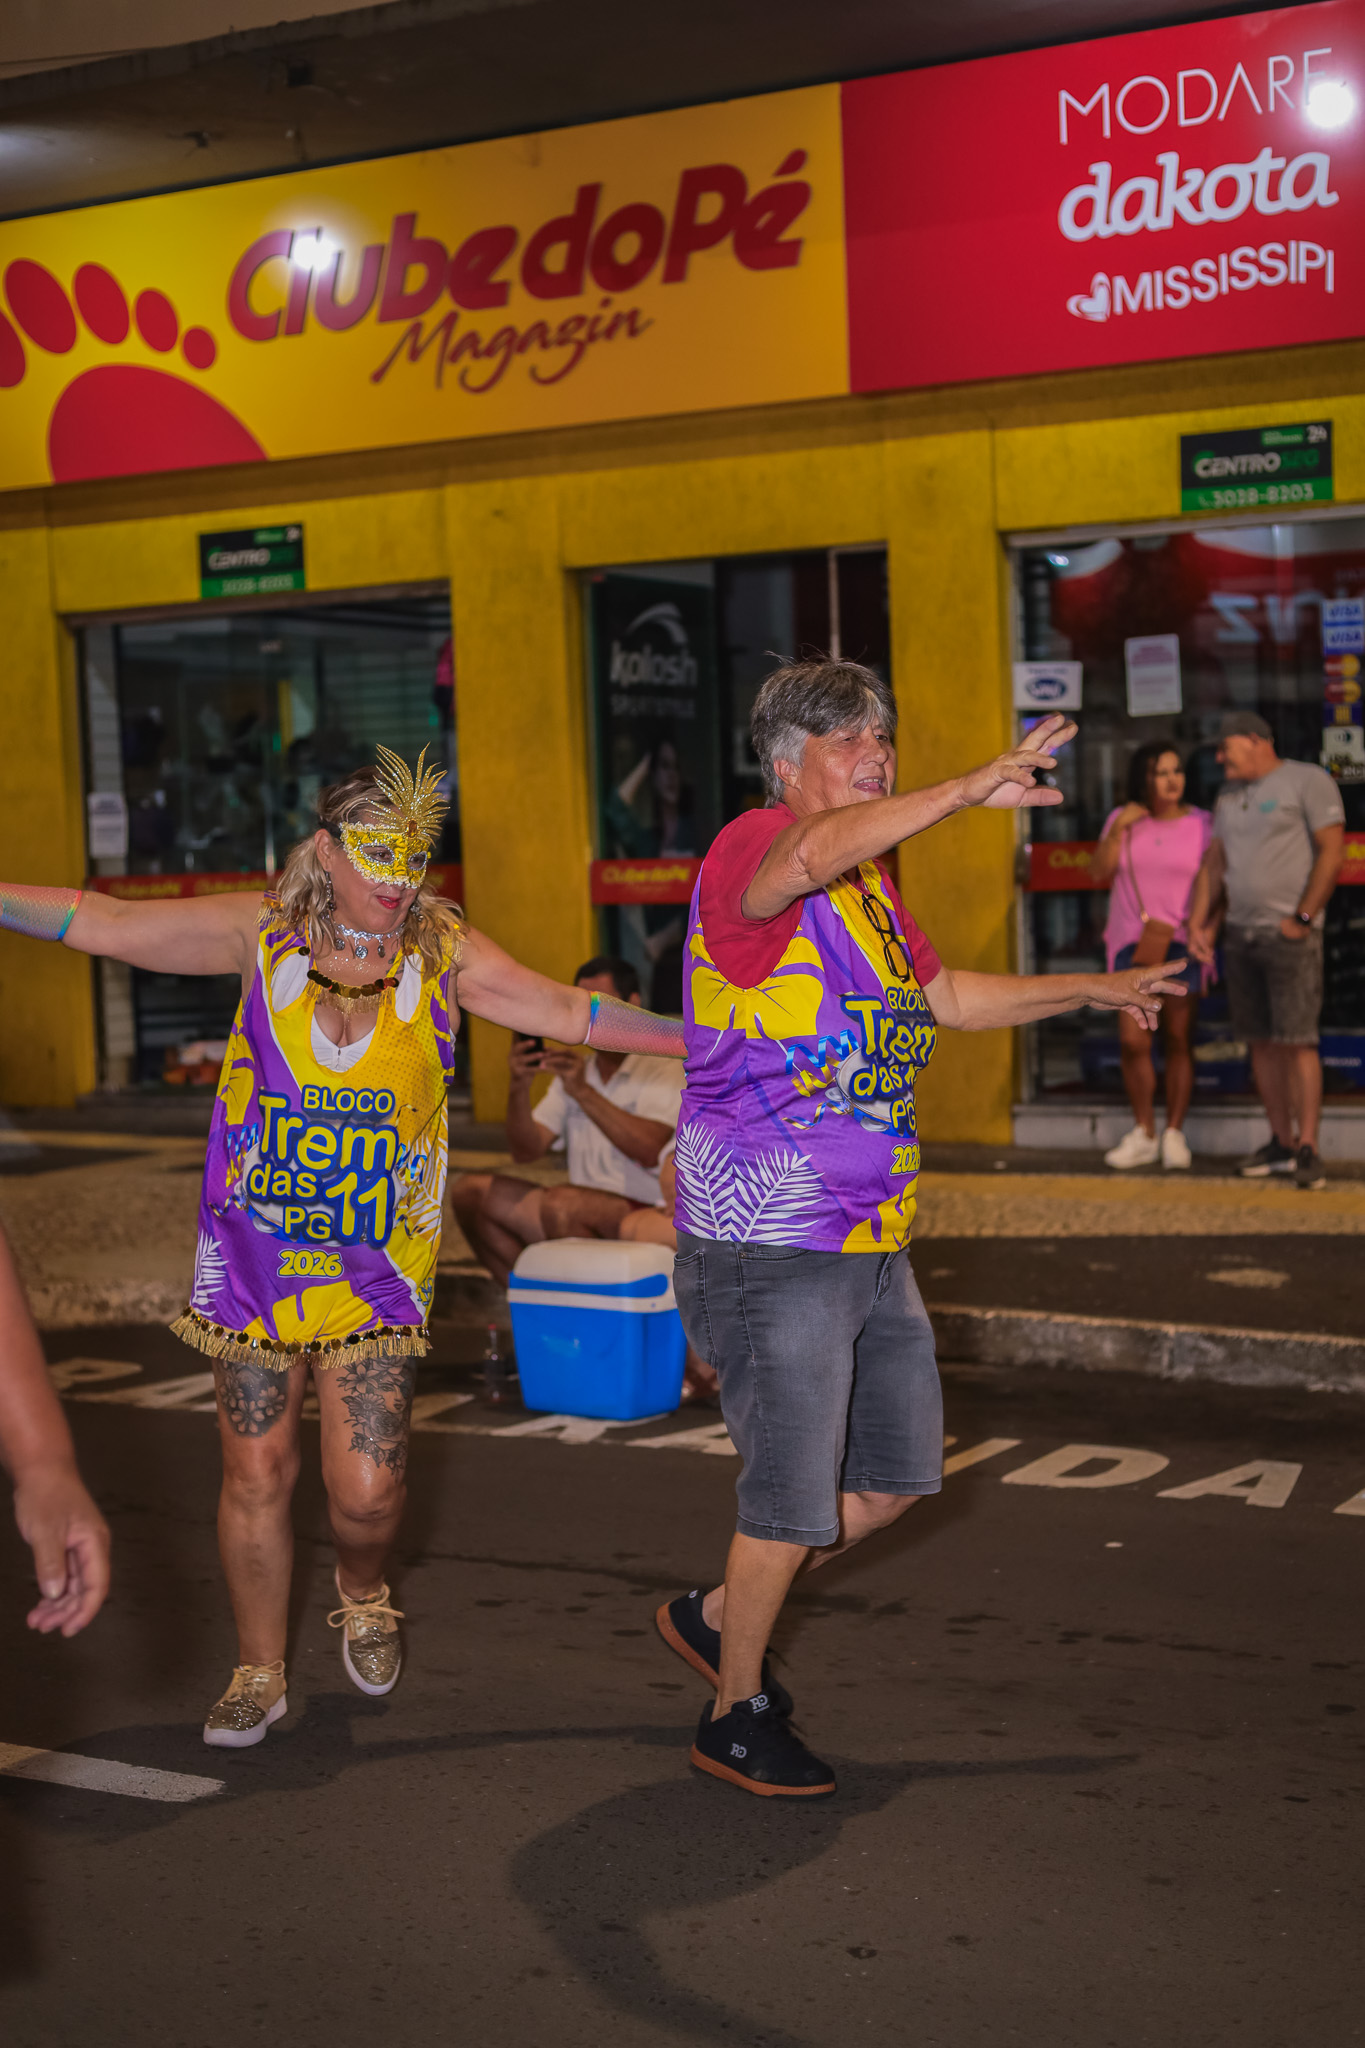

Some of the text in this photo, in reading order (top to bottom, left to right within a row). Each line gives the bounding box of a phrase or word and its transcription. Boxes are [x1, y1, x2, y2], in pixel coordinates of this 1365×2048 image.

[1058, 47, 1333, 145] MODARE
[1057, 146, 1340, 243] dakota
[1112, 239, 1335, 316] MISSISSIPI
[369, 297, 656, 395] Magazin
[844, 999, 937, 1063] Trem
[302, 1086, 395, 1115] BLOCO
[852, 1062, 903, 1098] das
[890, 1098, 917, 1132] PG
[257, 1093, 397, 1172] Trem
[248, 1162, 390, 1243] das 11
[281, 1205, 333, 1241] PG
[277, 1248, 344, 1278] 2026
